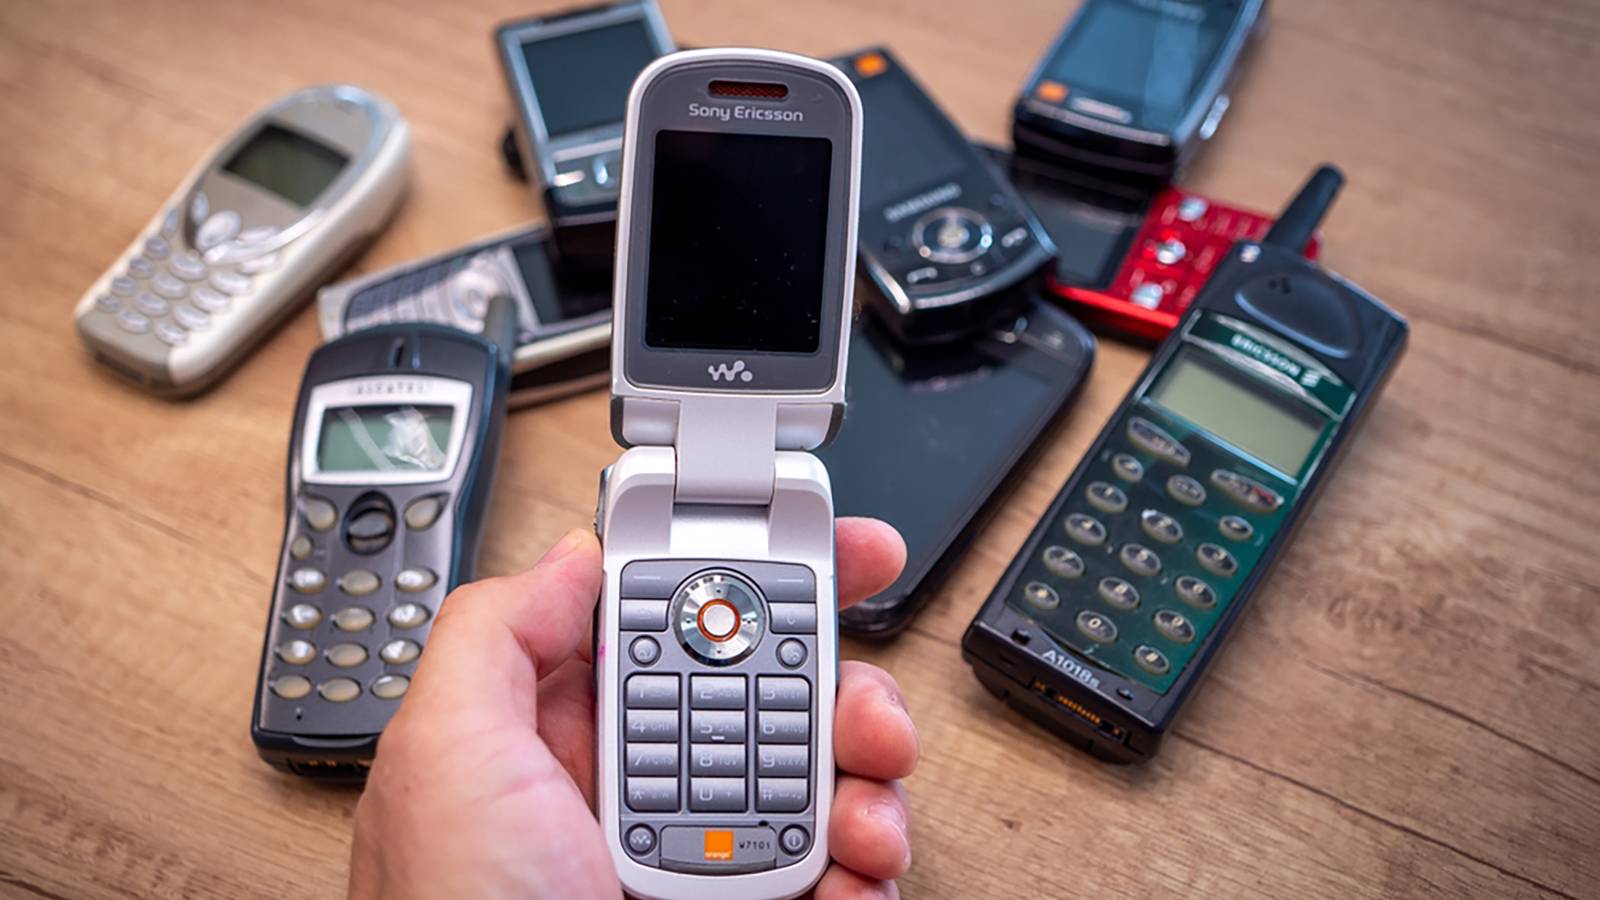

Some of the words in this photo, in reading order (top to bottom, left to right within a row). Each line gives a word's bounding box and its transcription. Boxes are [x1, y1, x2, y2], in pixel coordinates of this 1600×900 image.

[689, 103, 730, 121] Sony
[734, 105, 803, 122] Ericsson
[700, 718, 713, 734] 5
[762, 719, 776, 735] 6
[762, 751, 776, 768] 9
